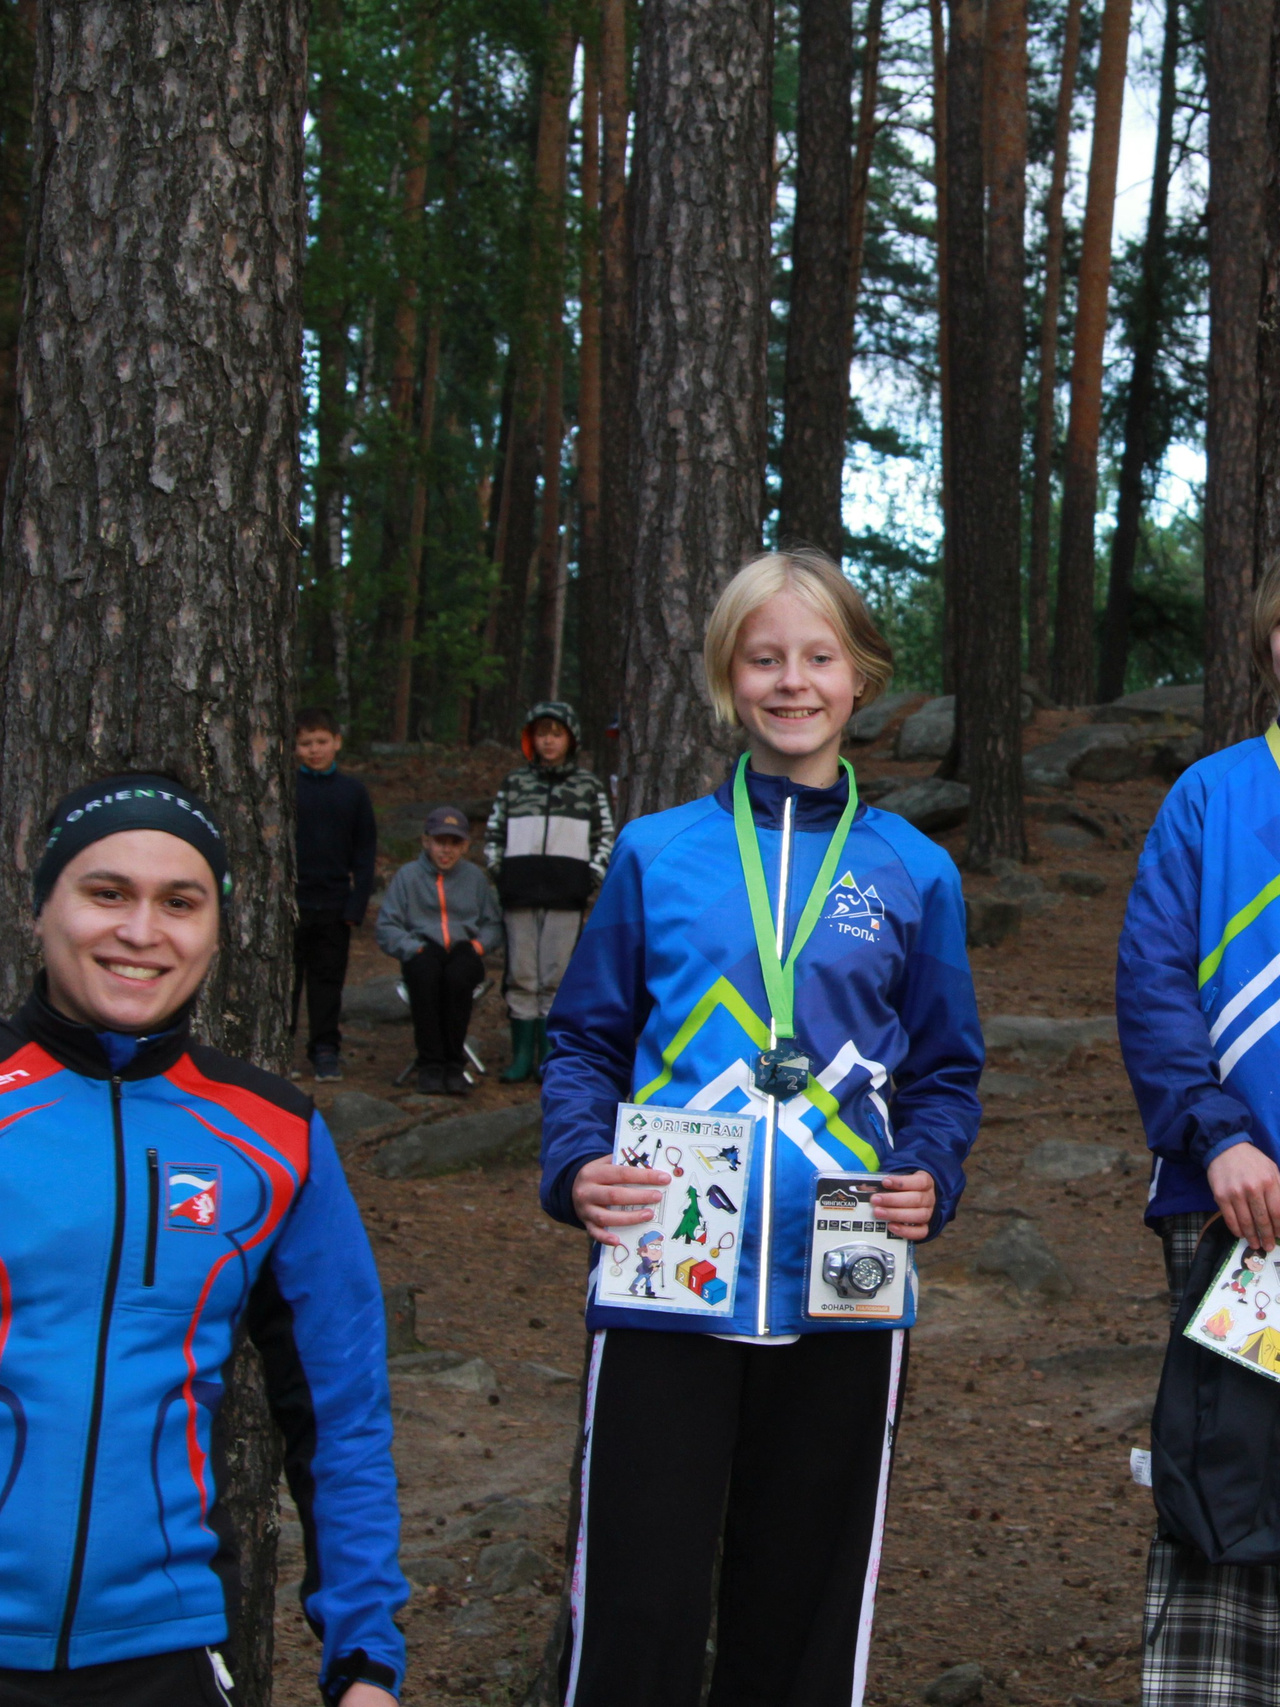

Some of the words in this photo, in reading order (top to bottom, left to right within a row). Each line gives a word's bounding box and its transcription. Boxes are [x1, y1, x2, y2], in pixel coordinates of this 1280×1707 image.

[838, 923, 875, 942] ТРОПА
[787, 1075, 798, 1091] 2
[651, 1119, 744, 1138] ORIENTEAM
